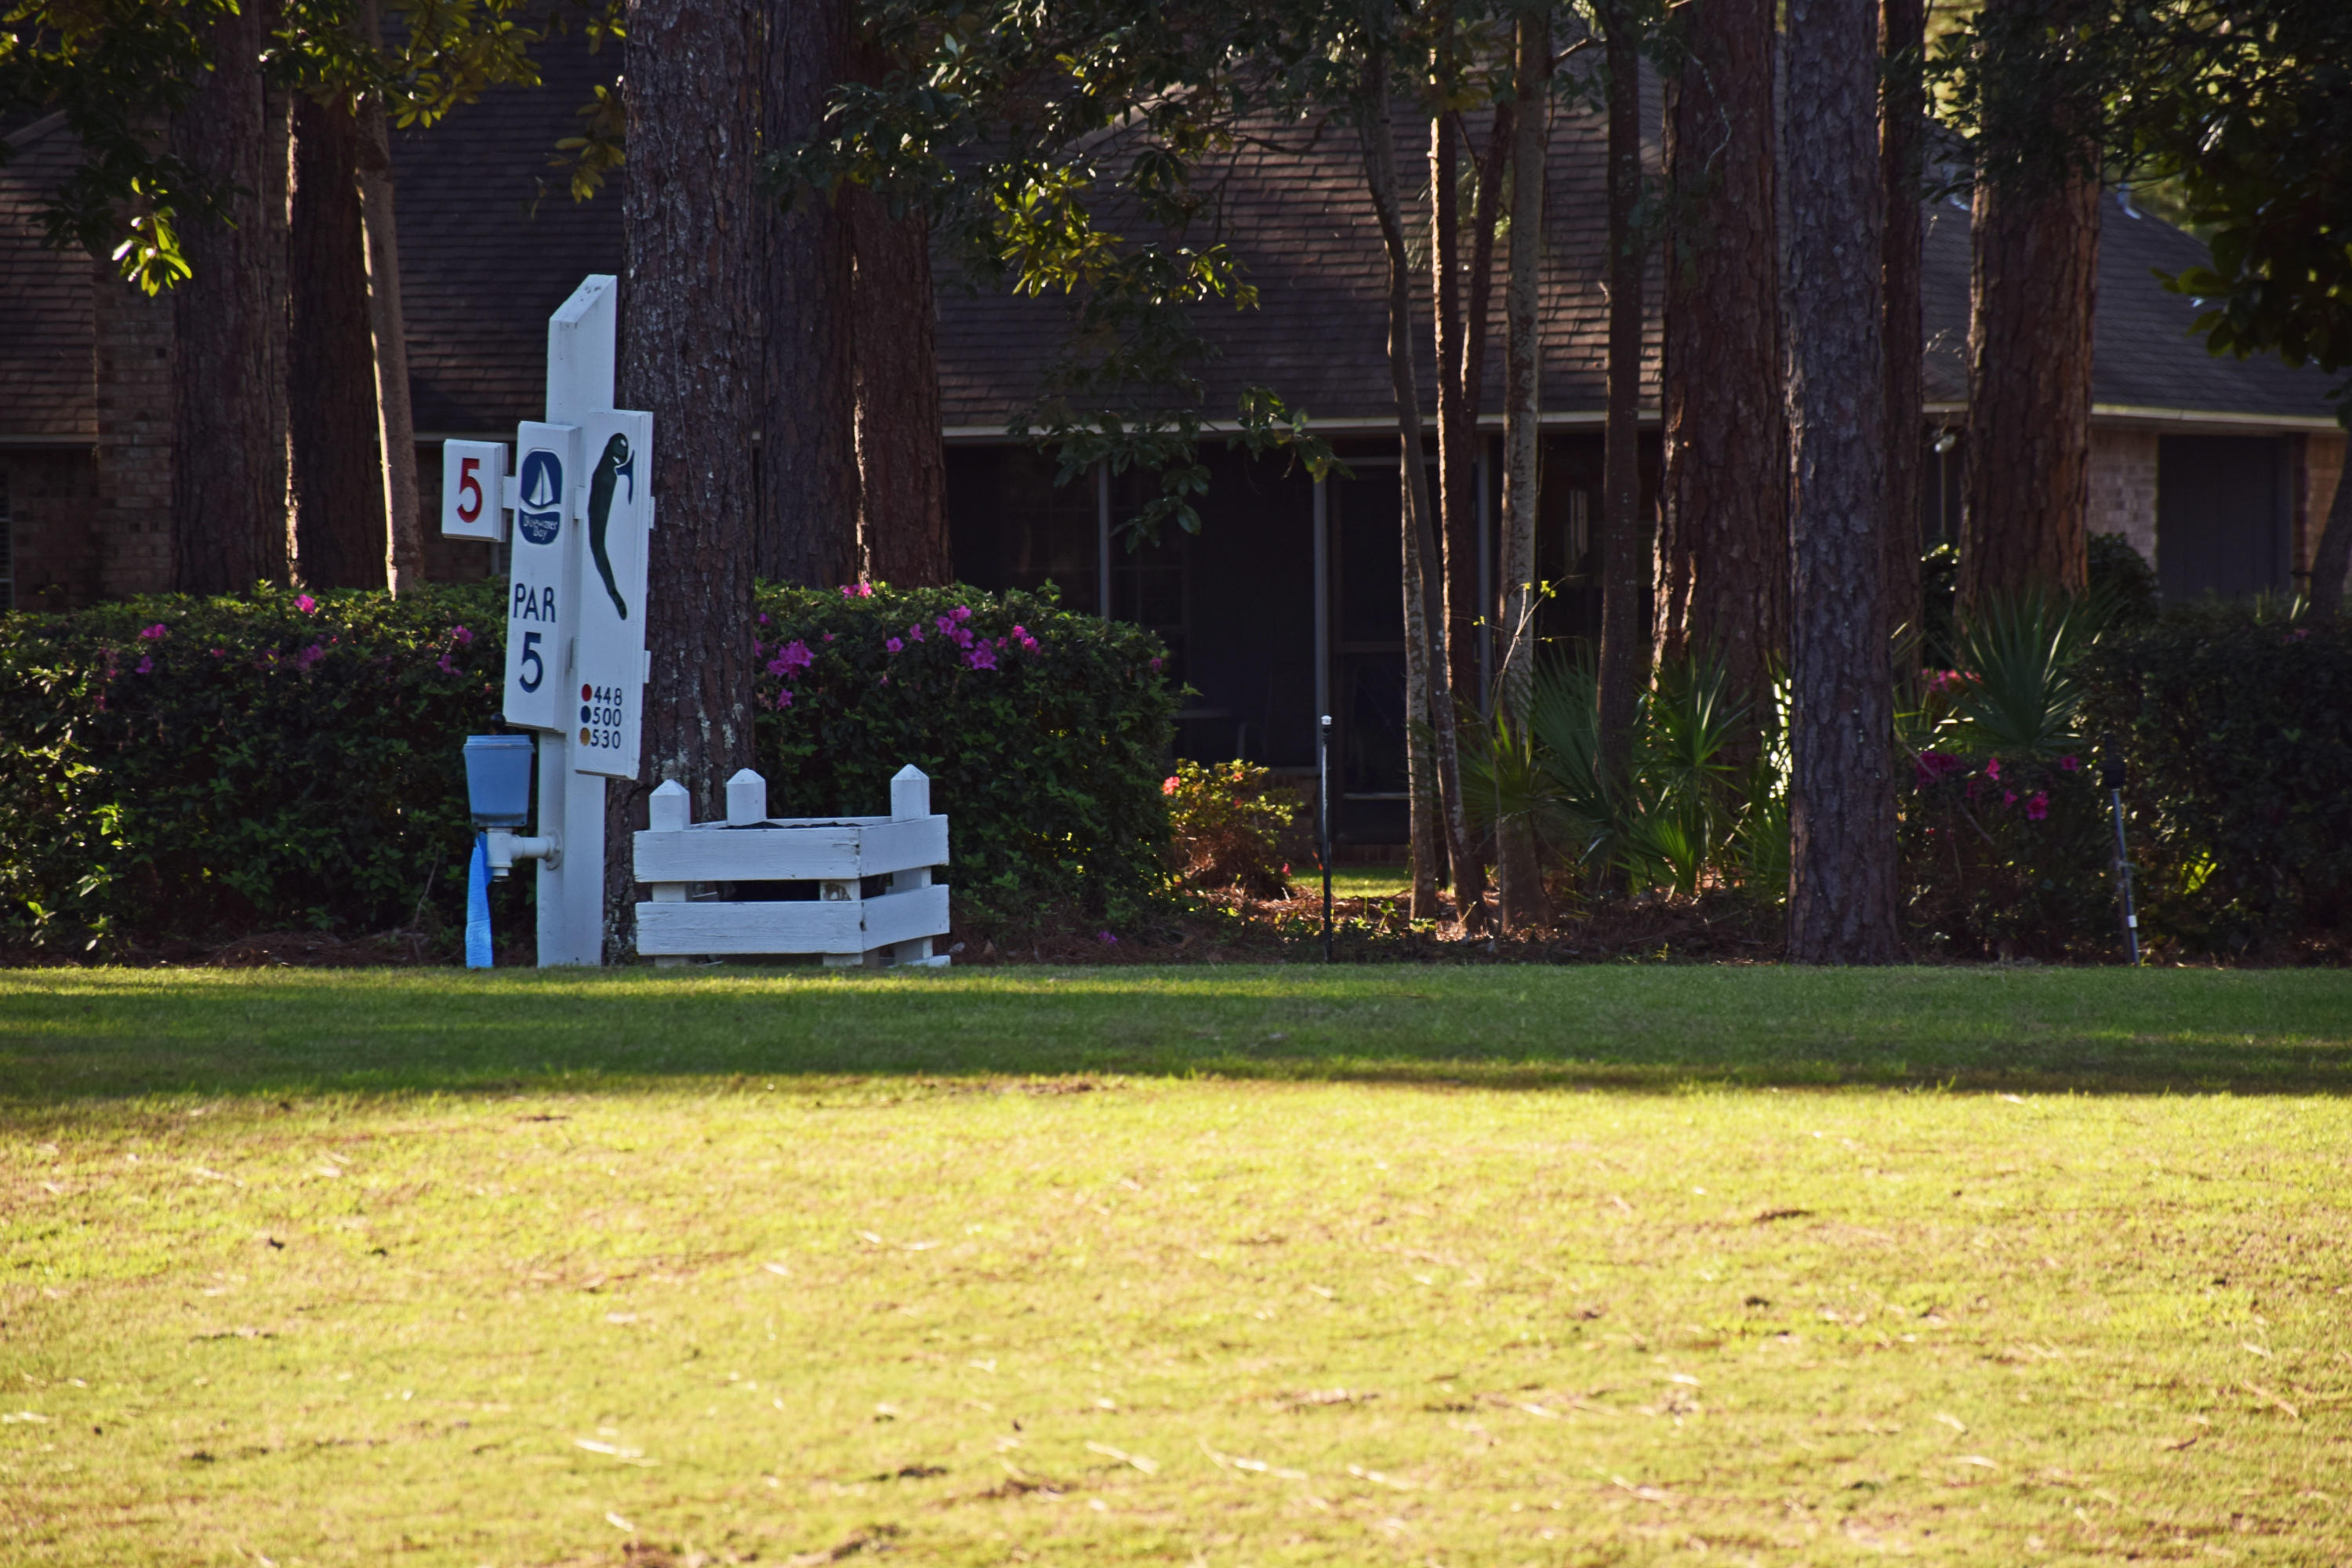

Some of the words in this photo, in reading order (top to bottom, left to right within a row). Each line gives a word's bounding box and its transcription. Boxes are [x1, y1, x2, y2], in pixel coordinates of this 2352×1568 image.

[456, 457, 483, 524] 5
[513, 583, 556, 623] PAR
[519, 630, 544, 694] 5
[593, 686, 622, 706] 448
[592, 706, 622, 728] 500
[590, 728, 621, 750] 530
